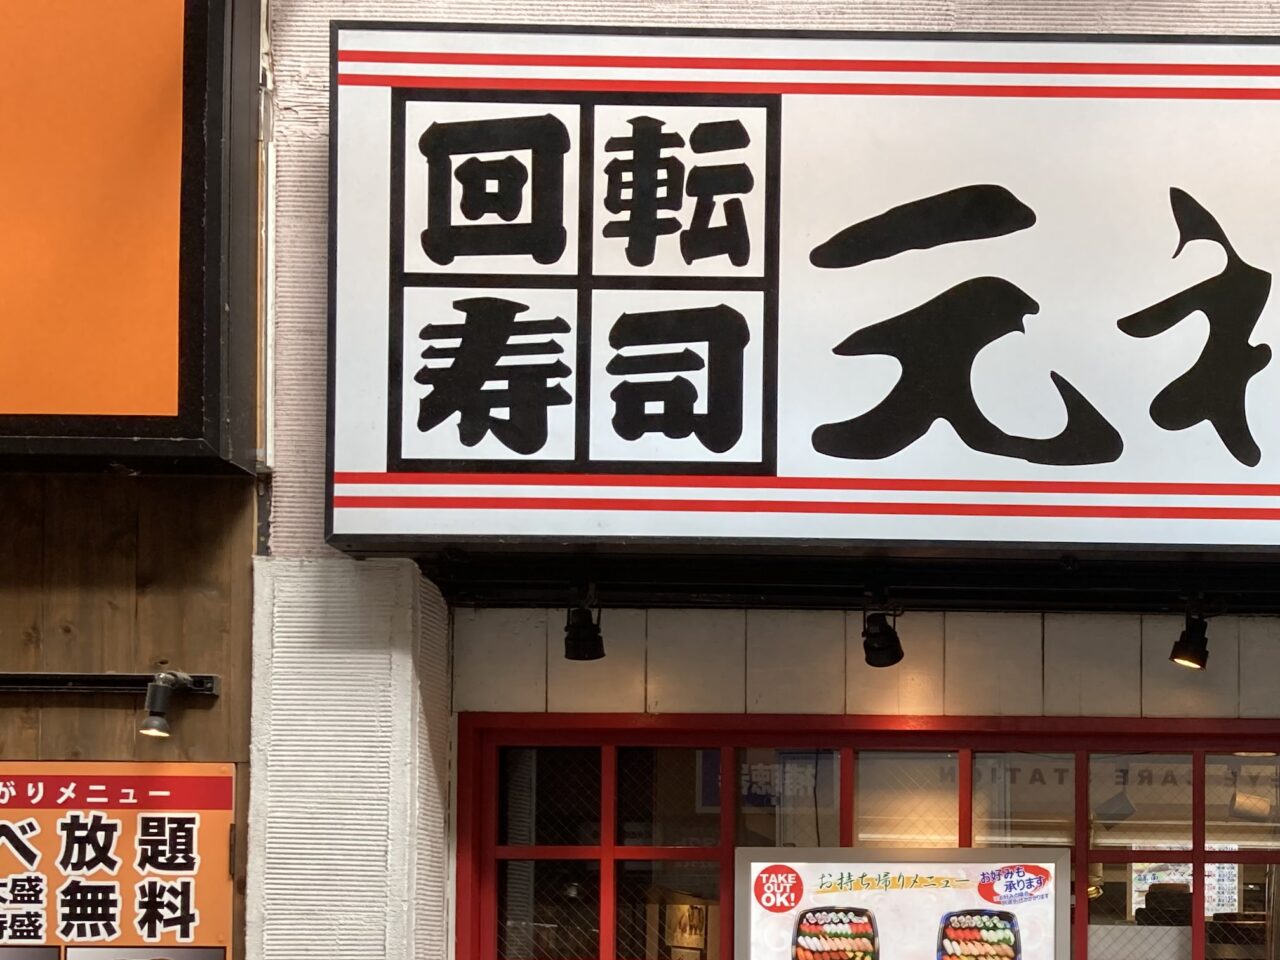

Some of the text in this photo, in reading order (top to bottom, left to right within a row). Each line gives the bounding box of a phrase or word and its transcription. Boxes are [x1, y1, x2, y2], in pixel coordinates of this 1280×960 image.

[0, 782, 171, 804] がりメニュー
[760, 873, 797, 884] TAKE
[818, 871, 970, 892] お持ち帰りメニュー
[764, 883, 792, 893] OUT
[761, 893, 796, 907] OK!
[60, 880, 196, 939] 無料
